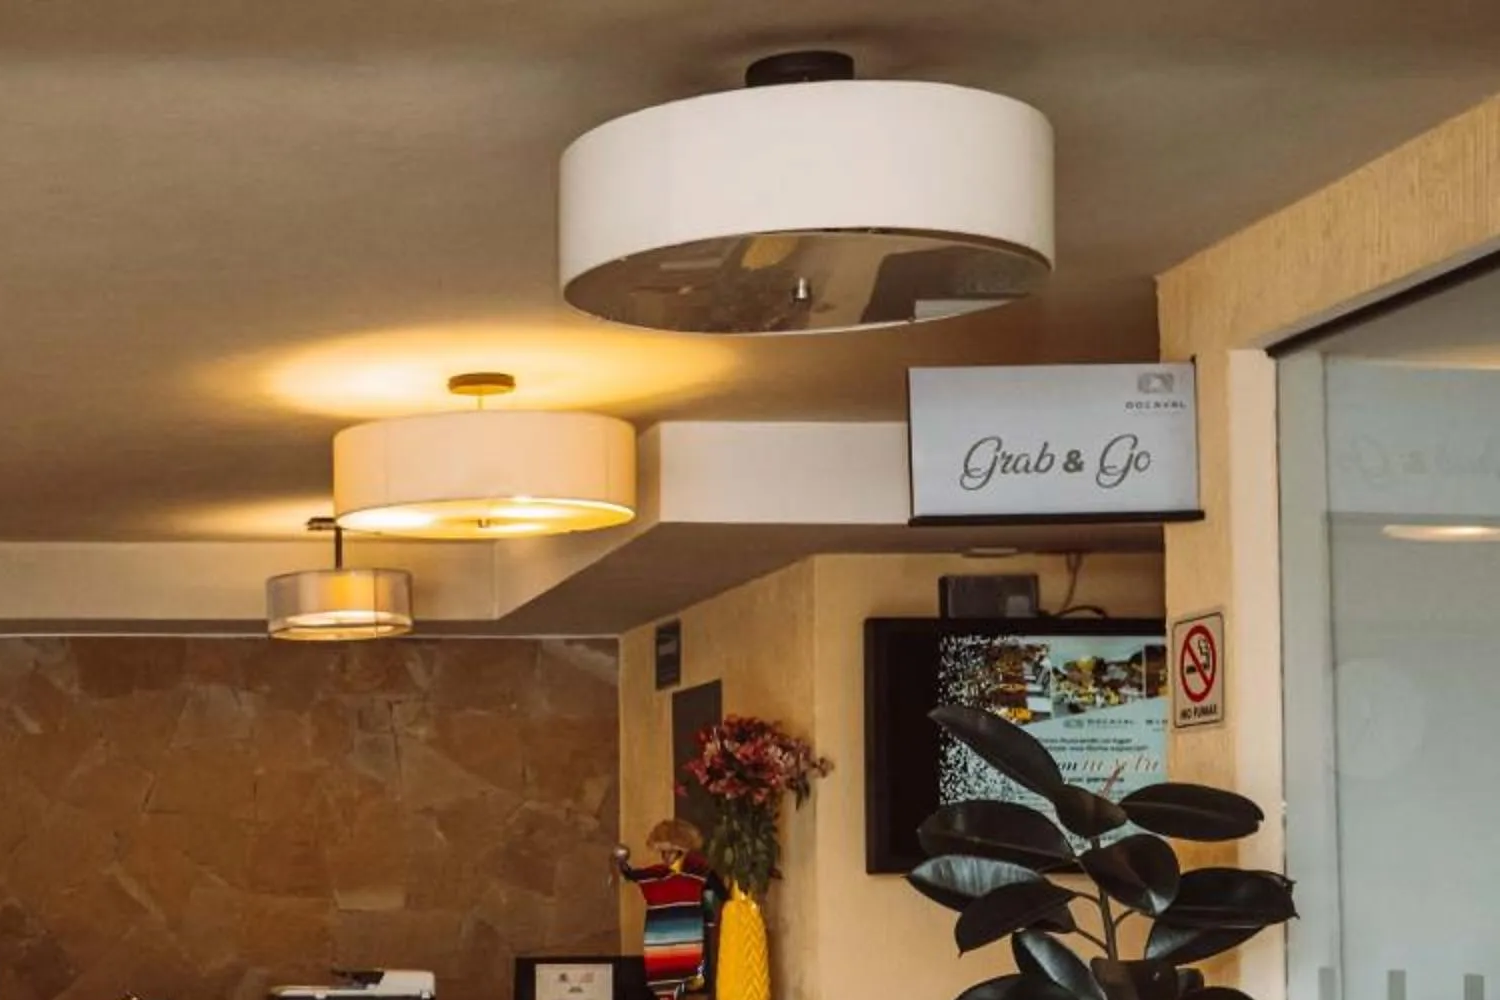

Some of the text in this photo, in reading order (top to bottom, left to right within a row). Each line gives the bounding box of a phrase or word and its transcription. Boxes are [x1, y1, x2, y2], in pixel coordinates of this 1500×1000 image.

[959, 433, 1152, 491] Grab & Go
[1180, 707, 1192, 720] NO
